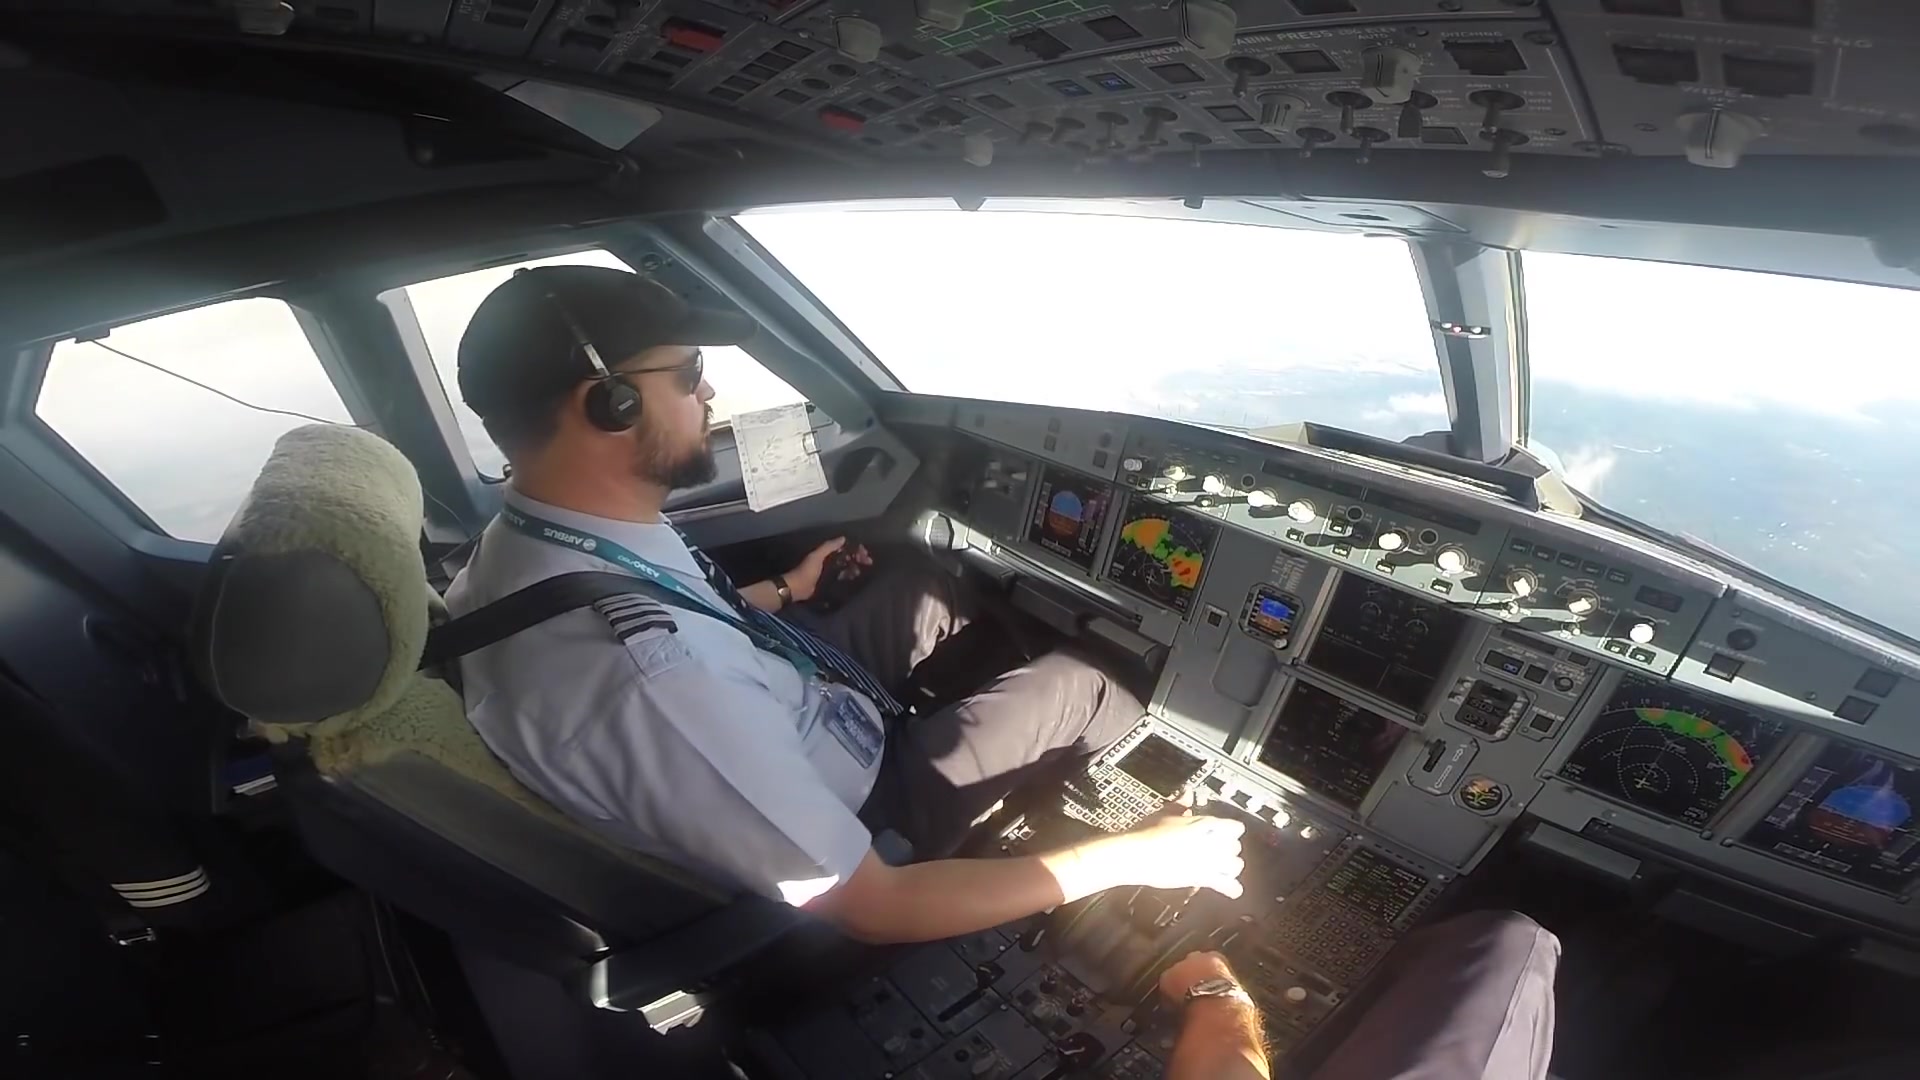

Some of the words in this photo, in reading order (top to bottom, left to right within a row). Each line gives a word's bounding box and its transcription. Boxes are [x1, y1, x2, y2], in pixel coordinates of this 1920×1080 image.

[1276, 30, 1333, 41] PRESS
[1811, 35, 1872, 48] ENG
[543, 527, 585, 545] AIRBUS
